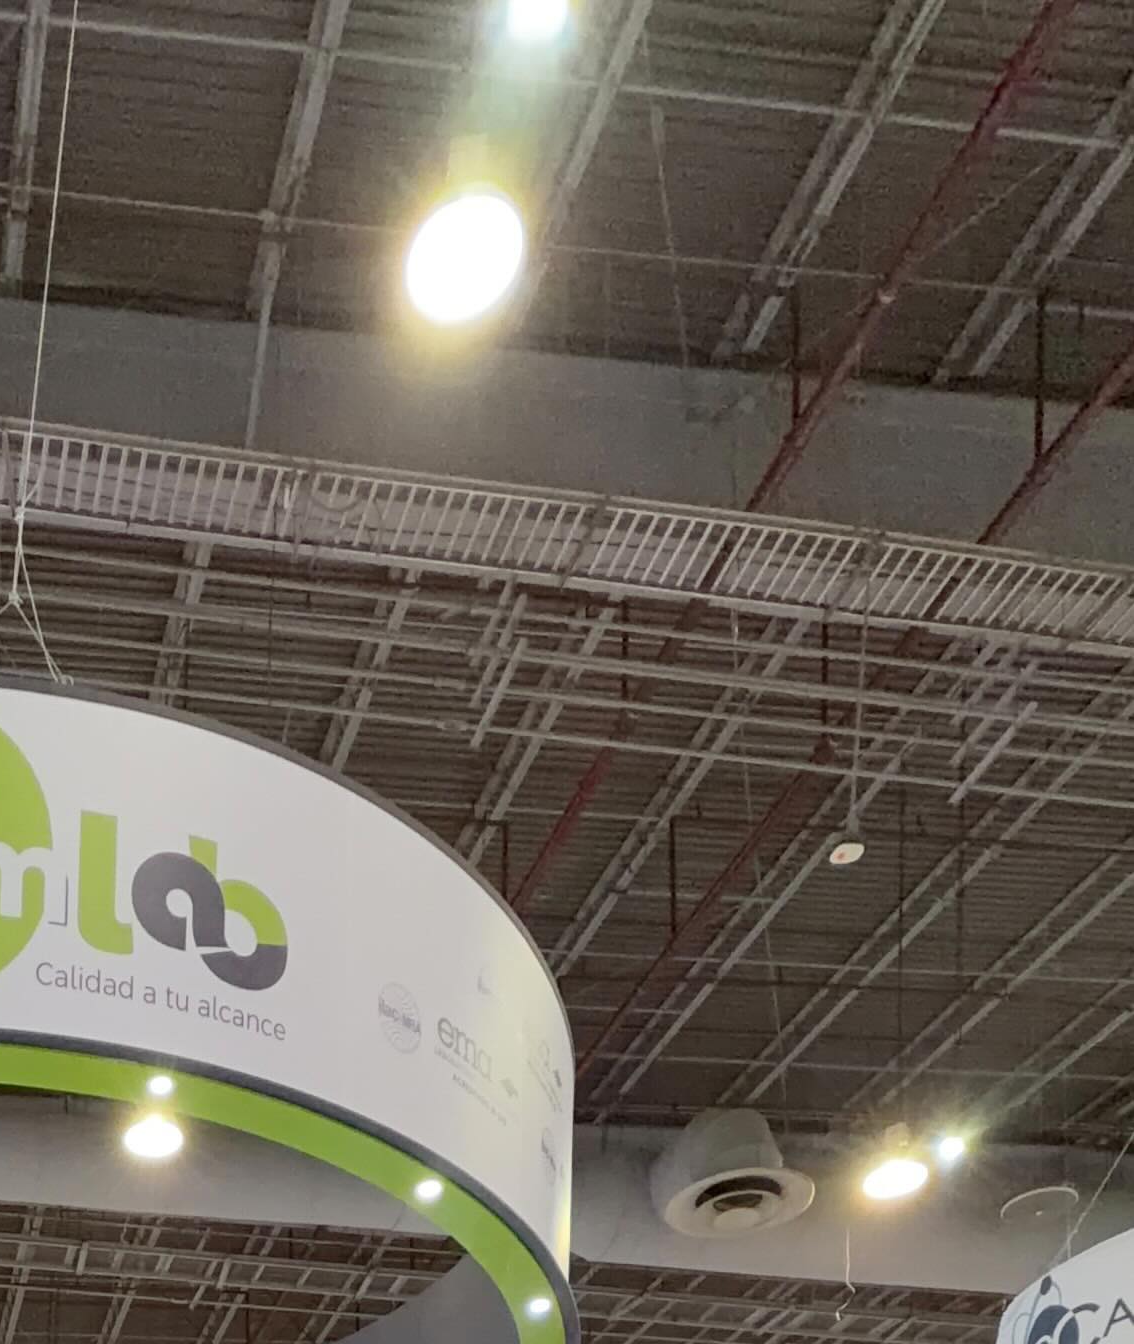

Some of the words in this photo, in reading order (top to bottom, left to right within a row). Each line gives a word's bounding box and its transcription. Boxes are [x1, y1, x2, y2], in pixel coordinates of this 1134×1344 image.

[35, 961, 134, 1001] Calidad
[143, 984, 157, 1005] a
[165, 987, 190, 1013] tu
[197, 997, 287, 1041] alcance
